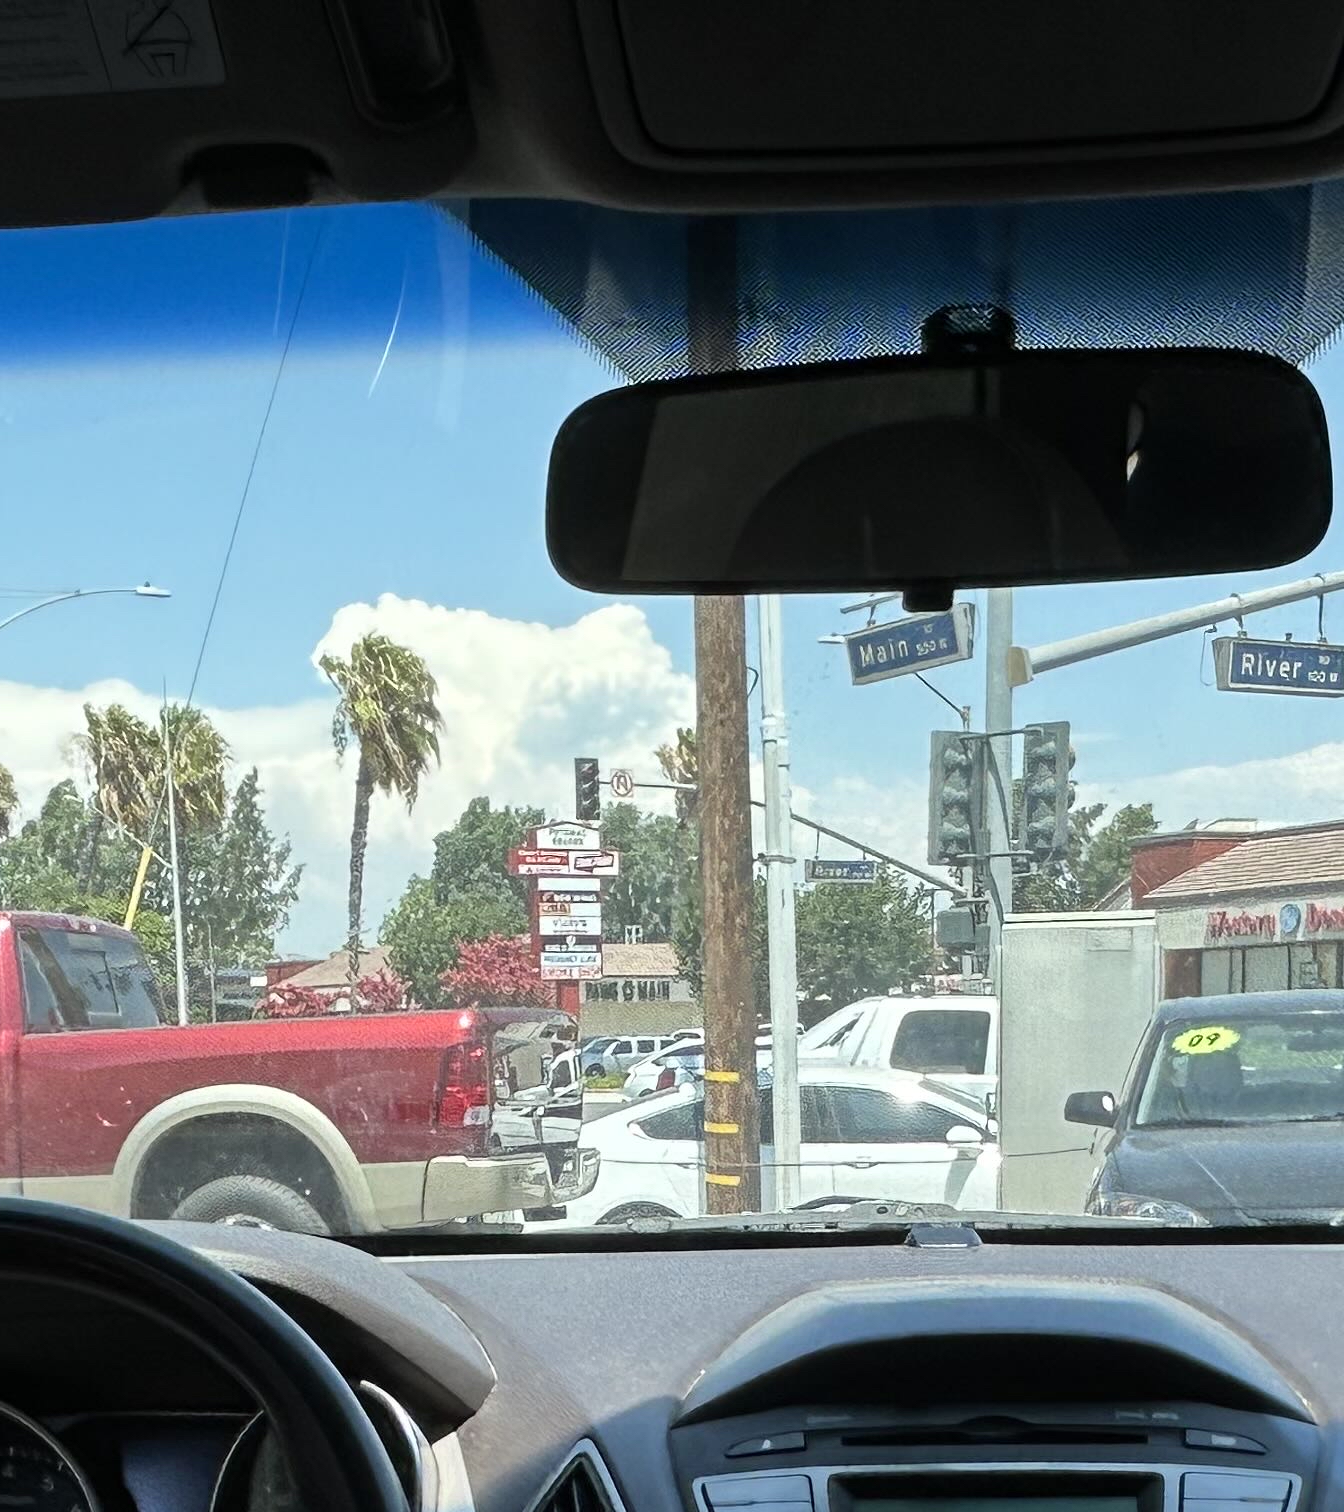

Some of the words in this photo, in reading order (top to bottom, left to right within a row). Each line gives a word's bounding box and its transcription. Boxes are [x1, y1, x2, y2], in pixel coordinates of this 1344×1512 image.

[859, 640, 908, 668] Main
[1241, 653, 1303, 680] River
[1188, 1032, 1221, 1048] 09
